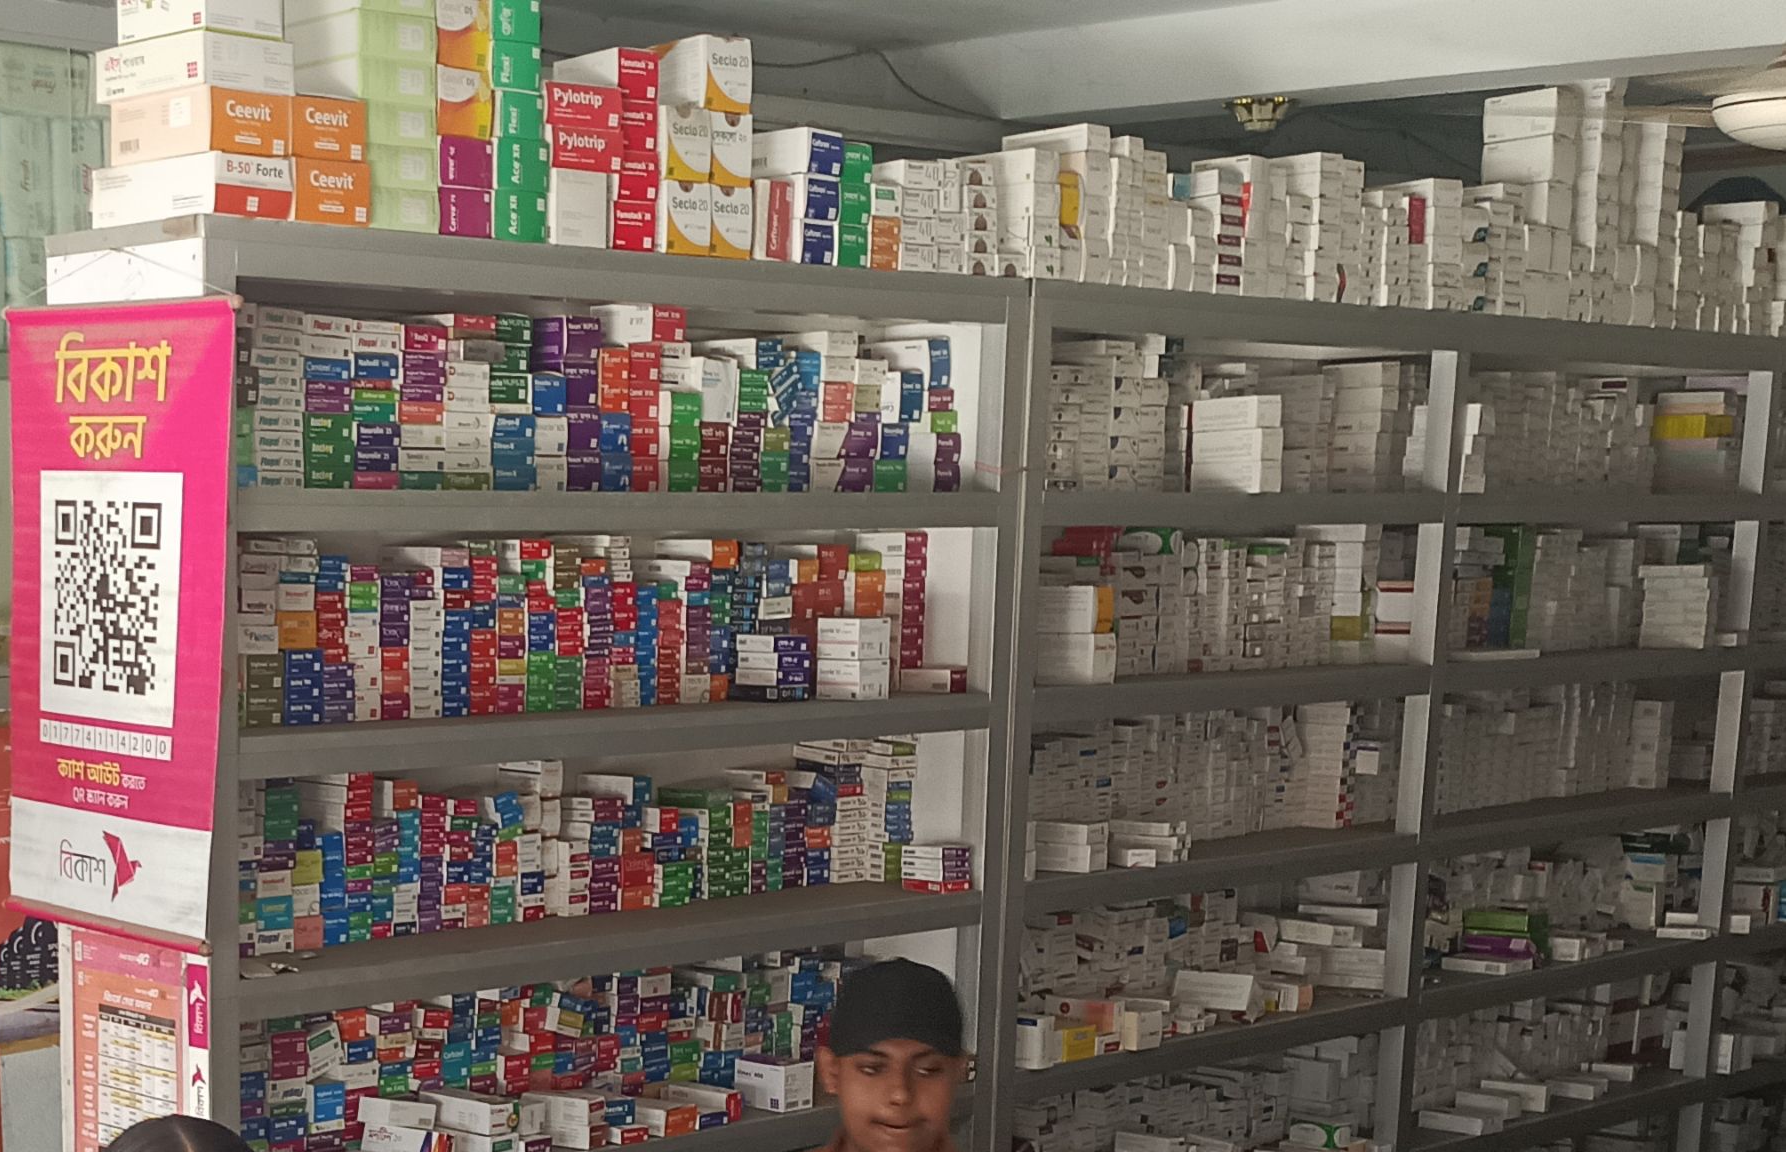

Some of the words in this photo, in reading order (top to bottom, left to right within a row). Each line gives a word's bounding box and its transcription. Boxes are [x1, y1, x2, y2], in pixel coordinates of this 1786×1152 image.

[501, 56, 511, 83] Flexi
[712, 52, 738, 68] Seclo
[739, 55, 749, 69] 20
[553, 87, 603, 108] Pylotrip
[226, 100, 271, 122] Ceevit
[305, 107, 349, 128] Ceevit
[509, 107, 518, 134] Flexi
[672, 122, 697, 136] Seclo
[698, 124, 709, 136] 20
[559, 131, 606, 152] Pylotrip
[513, 144, 521, 161] XR
[226, 160, 251, 175] B-50
[256, 163, 284, 179] Forte
[309, 170, 354, 190] Ceevit
[512, 163, 520, 184] Ace
[510, 195, 518, 210] XR
[672, 197, 697, 210] Seclo
[699, 199, 708, 210] 20
[714, 200, 738, 214] Seclo
[740, 203, 749, 214] 20
[509, 213, 517, 235] Ace
[55, 331, 171, 403] বিকাশ
[69, 414, 147, 460] করুন
[57, 758, 85, 781] ক্যাশ
[86, 761, 120, 787] আউট
[60, 838, 106, 886] বিকাশ
